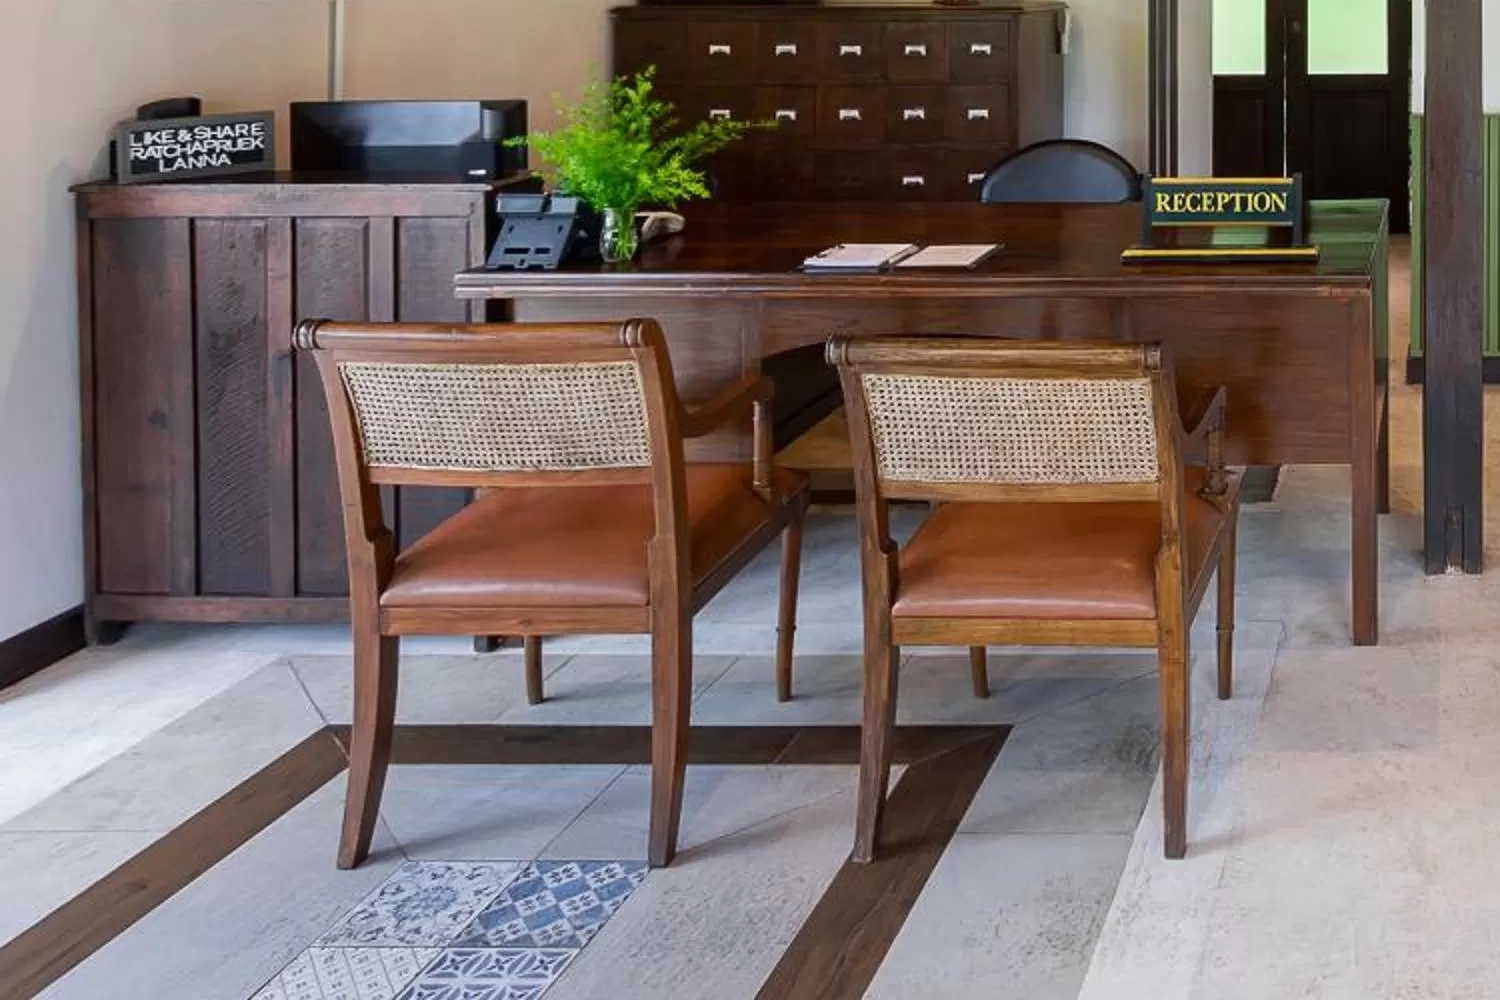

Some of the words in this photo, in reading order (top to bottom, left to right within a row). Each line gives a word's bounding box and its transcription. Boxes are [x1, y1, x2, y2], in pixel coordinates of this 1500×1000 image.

[128, 129, 175, 147] LIKE
[194, 121, 265, 139] SHARE
[129, 136, 265, 161] RATCHAPRUEK
[159, 153, 232, 173] LANNA
[1155, 191, 1288, 213] RECEPTION
